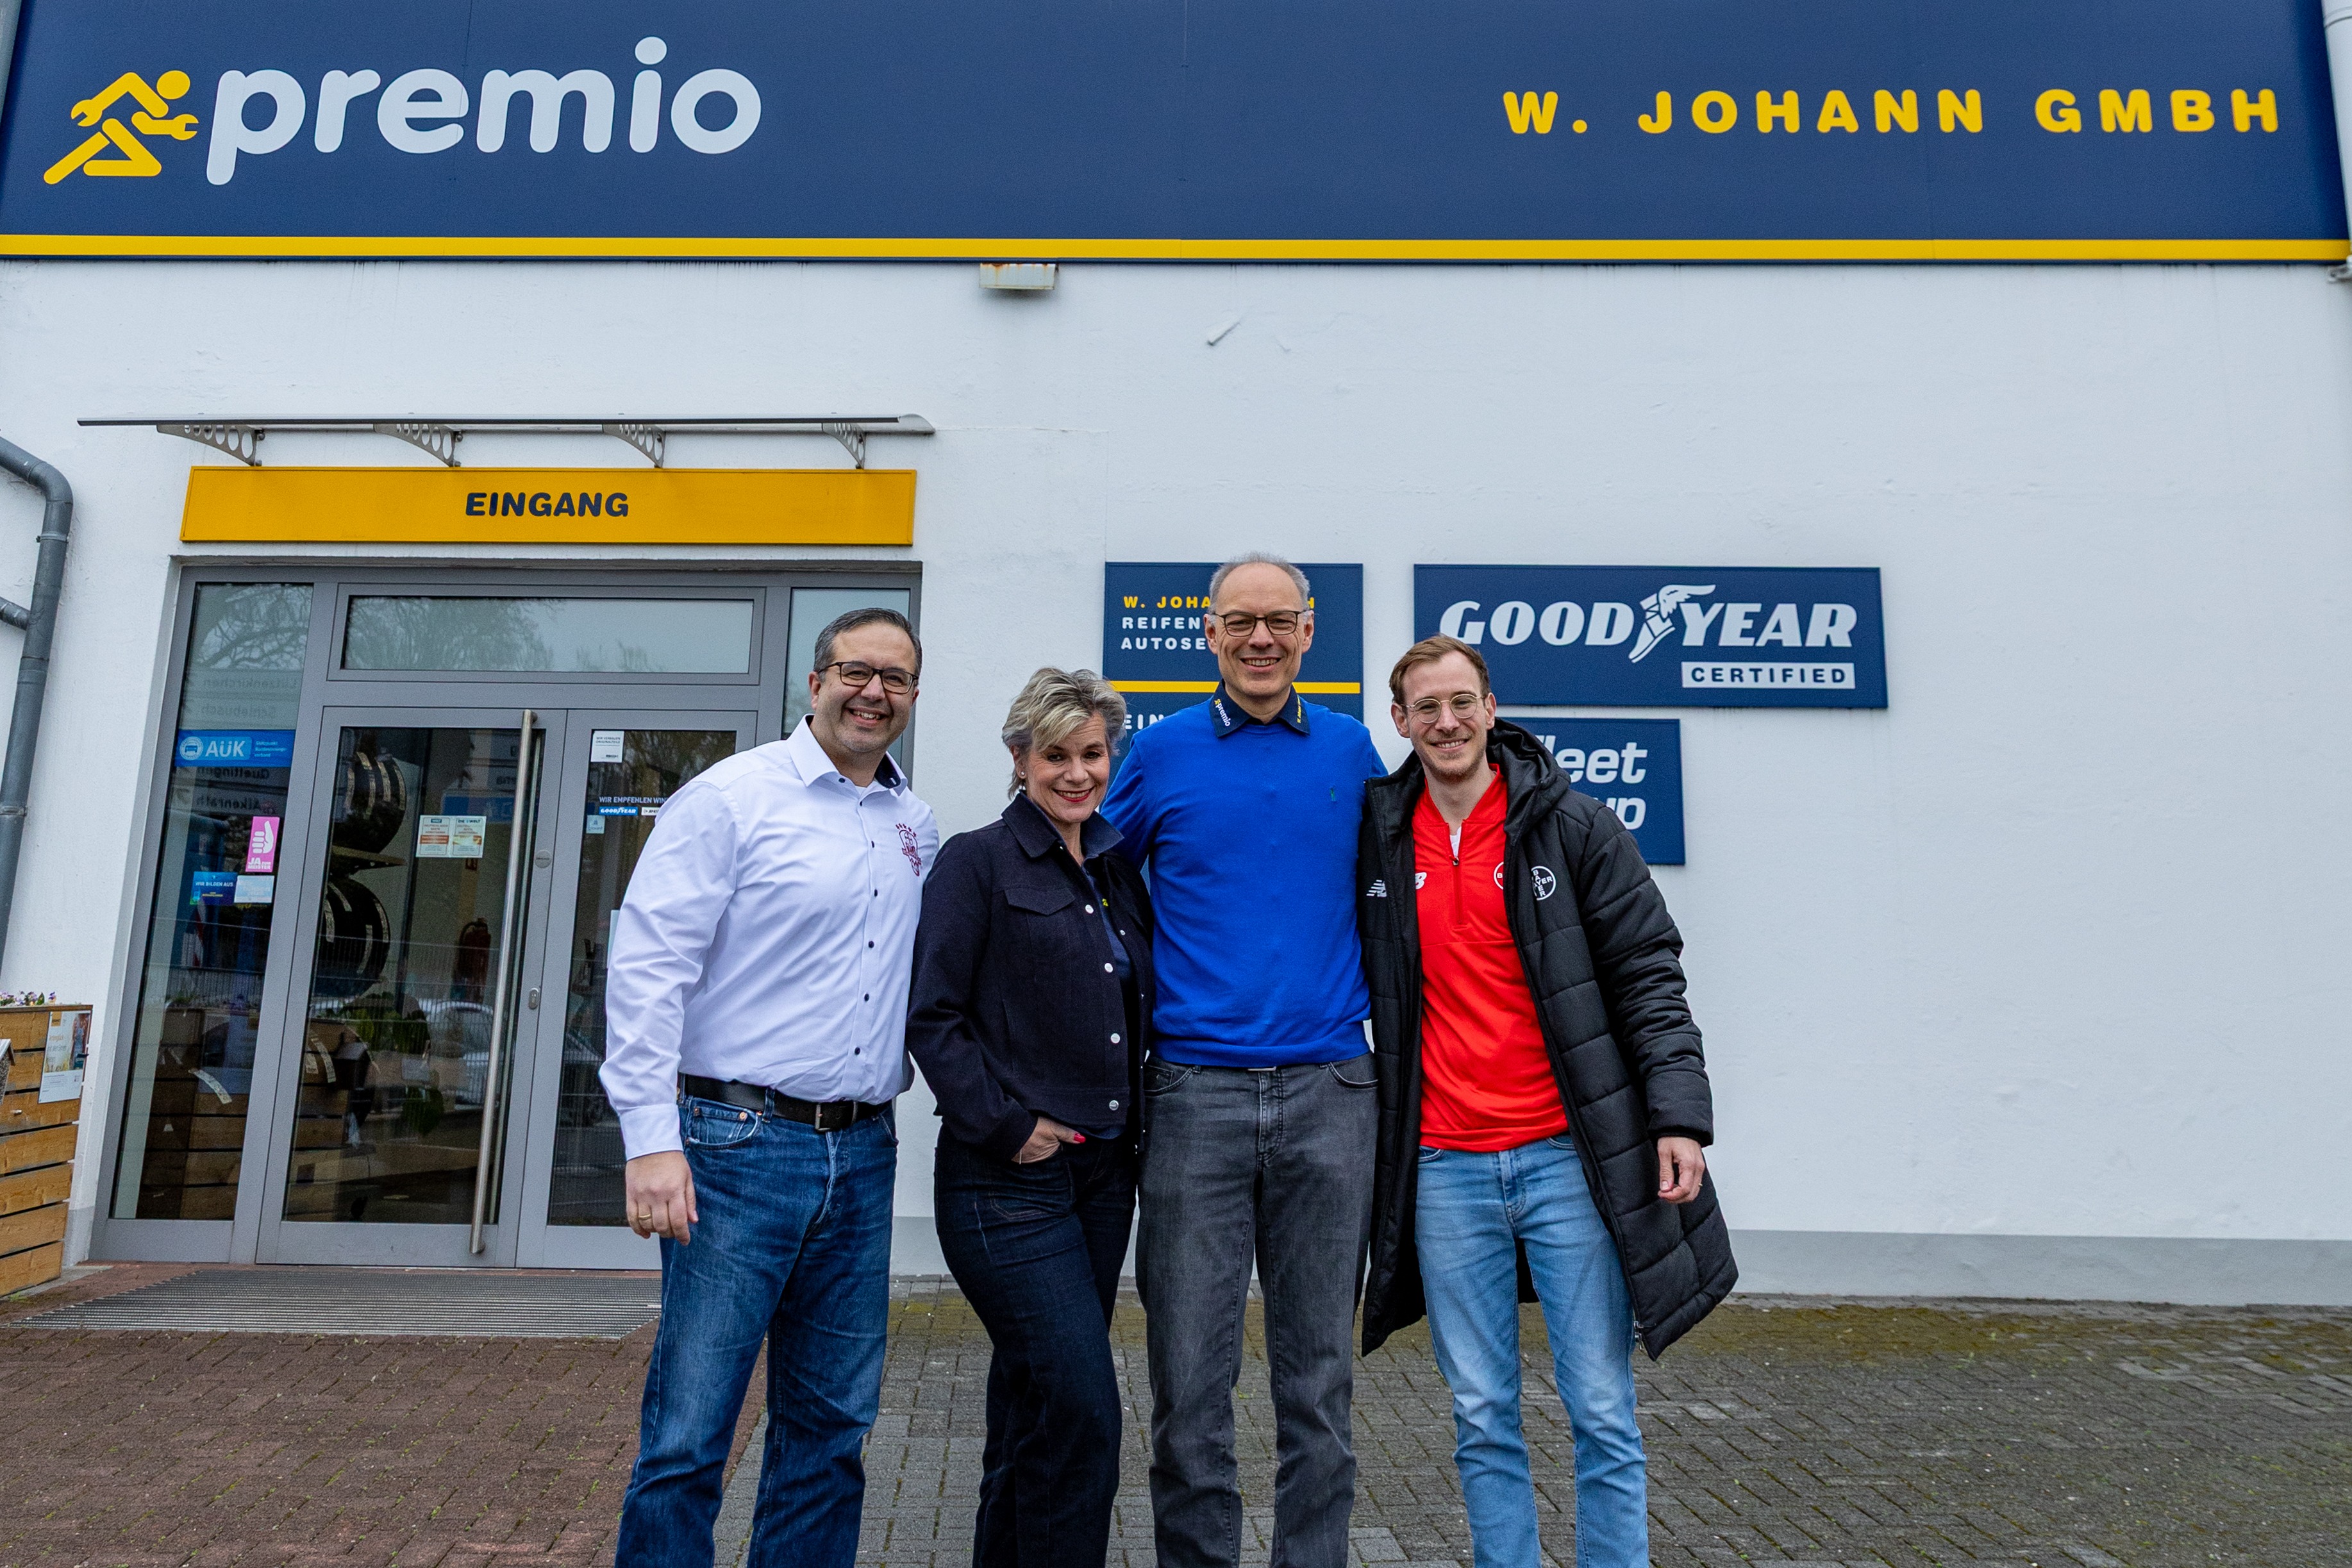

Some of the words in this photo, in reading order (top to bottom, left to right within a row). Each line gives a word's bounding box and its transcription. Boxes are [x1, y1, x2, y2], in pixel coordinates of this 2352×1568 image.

[207, 37, 761, 185] premio
[1503, 92, 1586, 133] W.
[1639, 90, 1982, 133] JOHANN
[2036, 89, 2278, 133] GMBH
[466, 492, 628, 517] EINGANG
[1123, 596, 1146, 608] W.
[1156, 596, 1210, 608] JOHA
[1121, 637, 1206, 650] AUTOSE
[1691, 667, 1845, 683] CERTIFIED
[1215, 703, 1231, 727] premio
